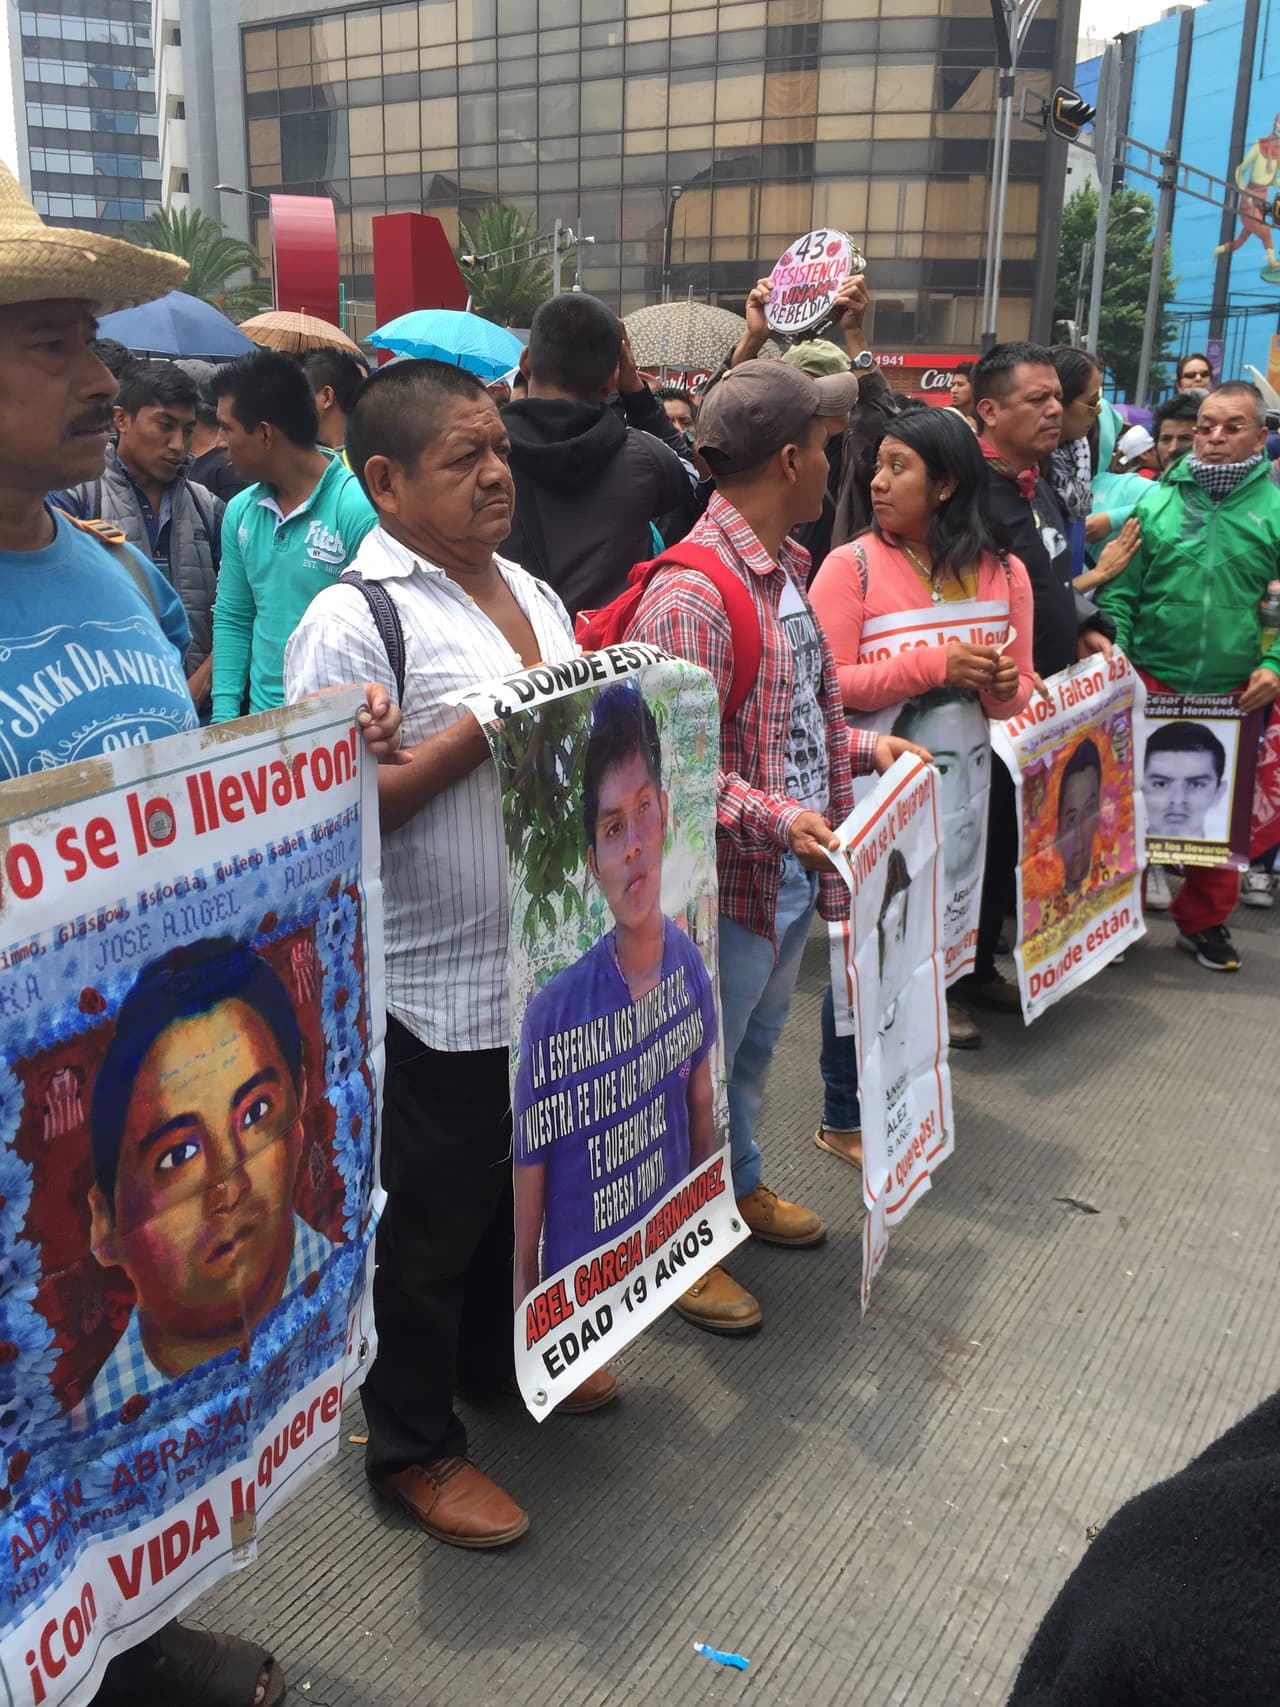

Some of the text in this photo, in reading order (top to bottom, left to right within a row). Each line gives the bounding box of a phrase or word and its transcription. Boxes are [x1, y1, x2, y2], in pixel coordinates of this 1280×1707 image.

[773, 257, 847, 287] RESISTENCIA
[796, 231, 828, 262] 43
[769, 295, 831, 324] REBELDIA
[781, 279, 831, 305] UNAM
[11, 661, 83, 738] JACK
[503, 653, 607, 704] DONDE
[1058, 671, 1104, 711] faltan
[1183, 695, 1234, 705] Manuel
[102, 726, 150, 753] Old
[56, 816, 120, 882] se
[126, 791, 178, 856] lo
[185, 726, 358, 836] llevaron!
[58, 906, 131, 945] Glasgow,
[140, 873, 208, 910] Escocia,
[216, 853, 264, 881] quiero
[95, 923, 153, 972] JOSE
[161, 889, 241, 943] ANGEL
[1030, 943, 1083, 998] Dónde
[1086, 907, 1131, 953] están
[532, 1039, 546, 1089] LA
[549, 1016, 612, 1082] ESPERANZA
[614, 1004, 633, 1056] NOS
[524, 1091, 574, 1154] NUESTRA
[577, 1082, 590, 1130] FE
[594, 1069, 617, 1123] DICE
[620, 1060, 638, 1111] QUE
[588, 1133, 602, 1181] TE
[605, 1111, 649, 1170] QUEREMOS
[593, 1173, 636, 1234] REGRESA
[526, 1156, 726, 1351] ABEL GARCIA HERNANDEZ
[542, 1218, 714, 1380] EDAD 19 AÑOS
[10, 1478, 83, 1574] ADÁN
[25, 1581, 98, 1707] ¡Con
[106, 1498, 221, 1601] VIDA
